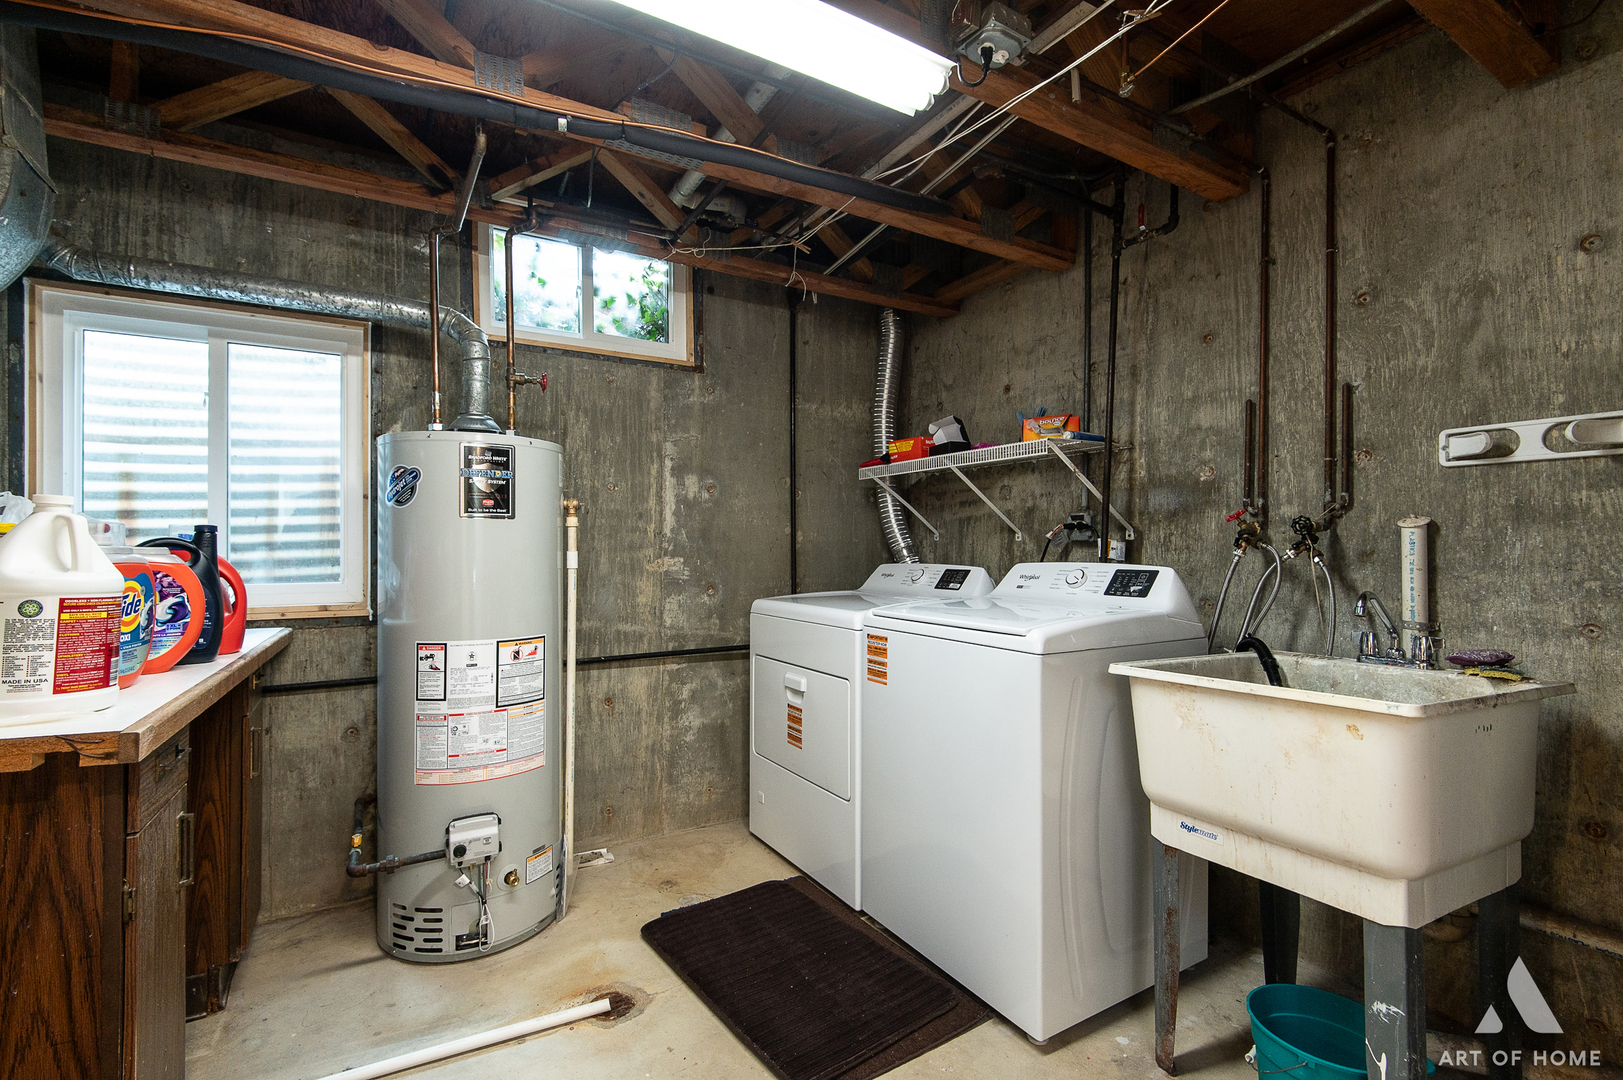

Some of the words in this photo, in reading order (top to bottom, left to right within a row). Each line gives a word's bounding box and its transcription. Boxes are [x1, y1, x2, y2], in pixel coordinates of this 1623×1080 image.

[1039, 416, 1065, 425] bounce
[460, 468, 514, 479] DEFENDER
[119, 633, 131, 642] OXI
